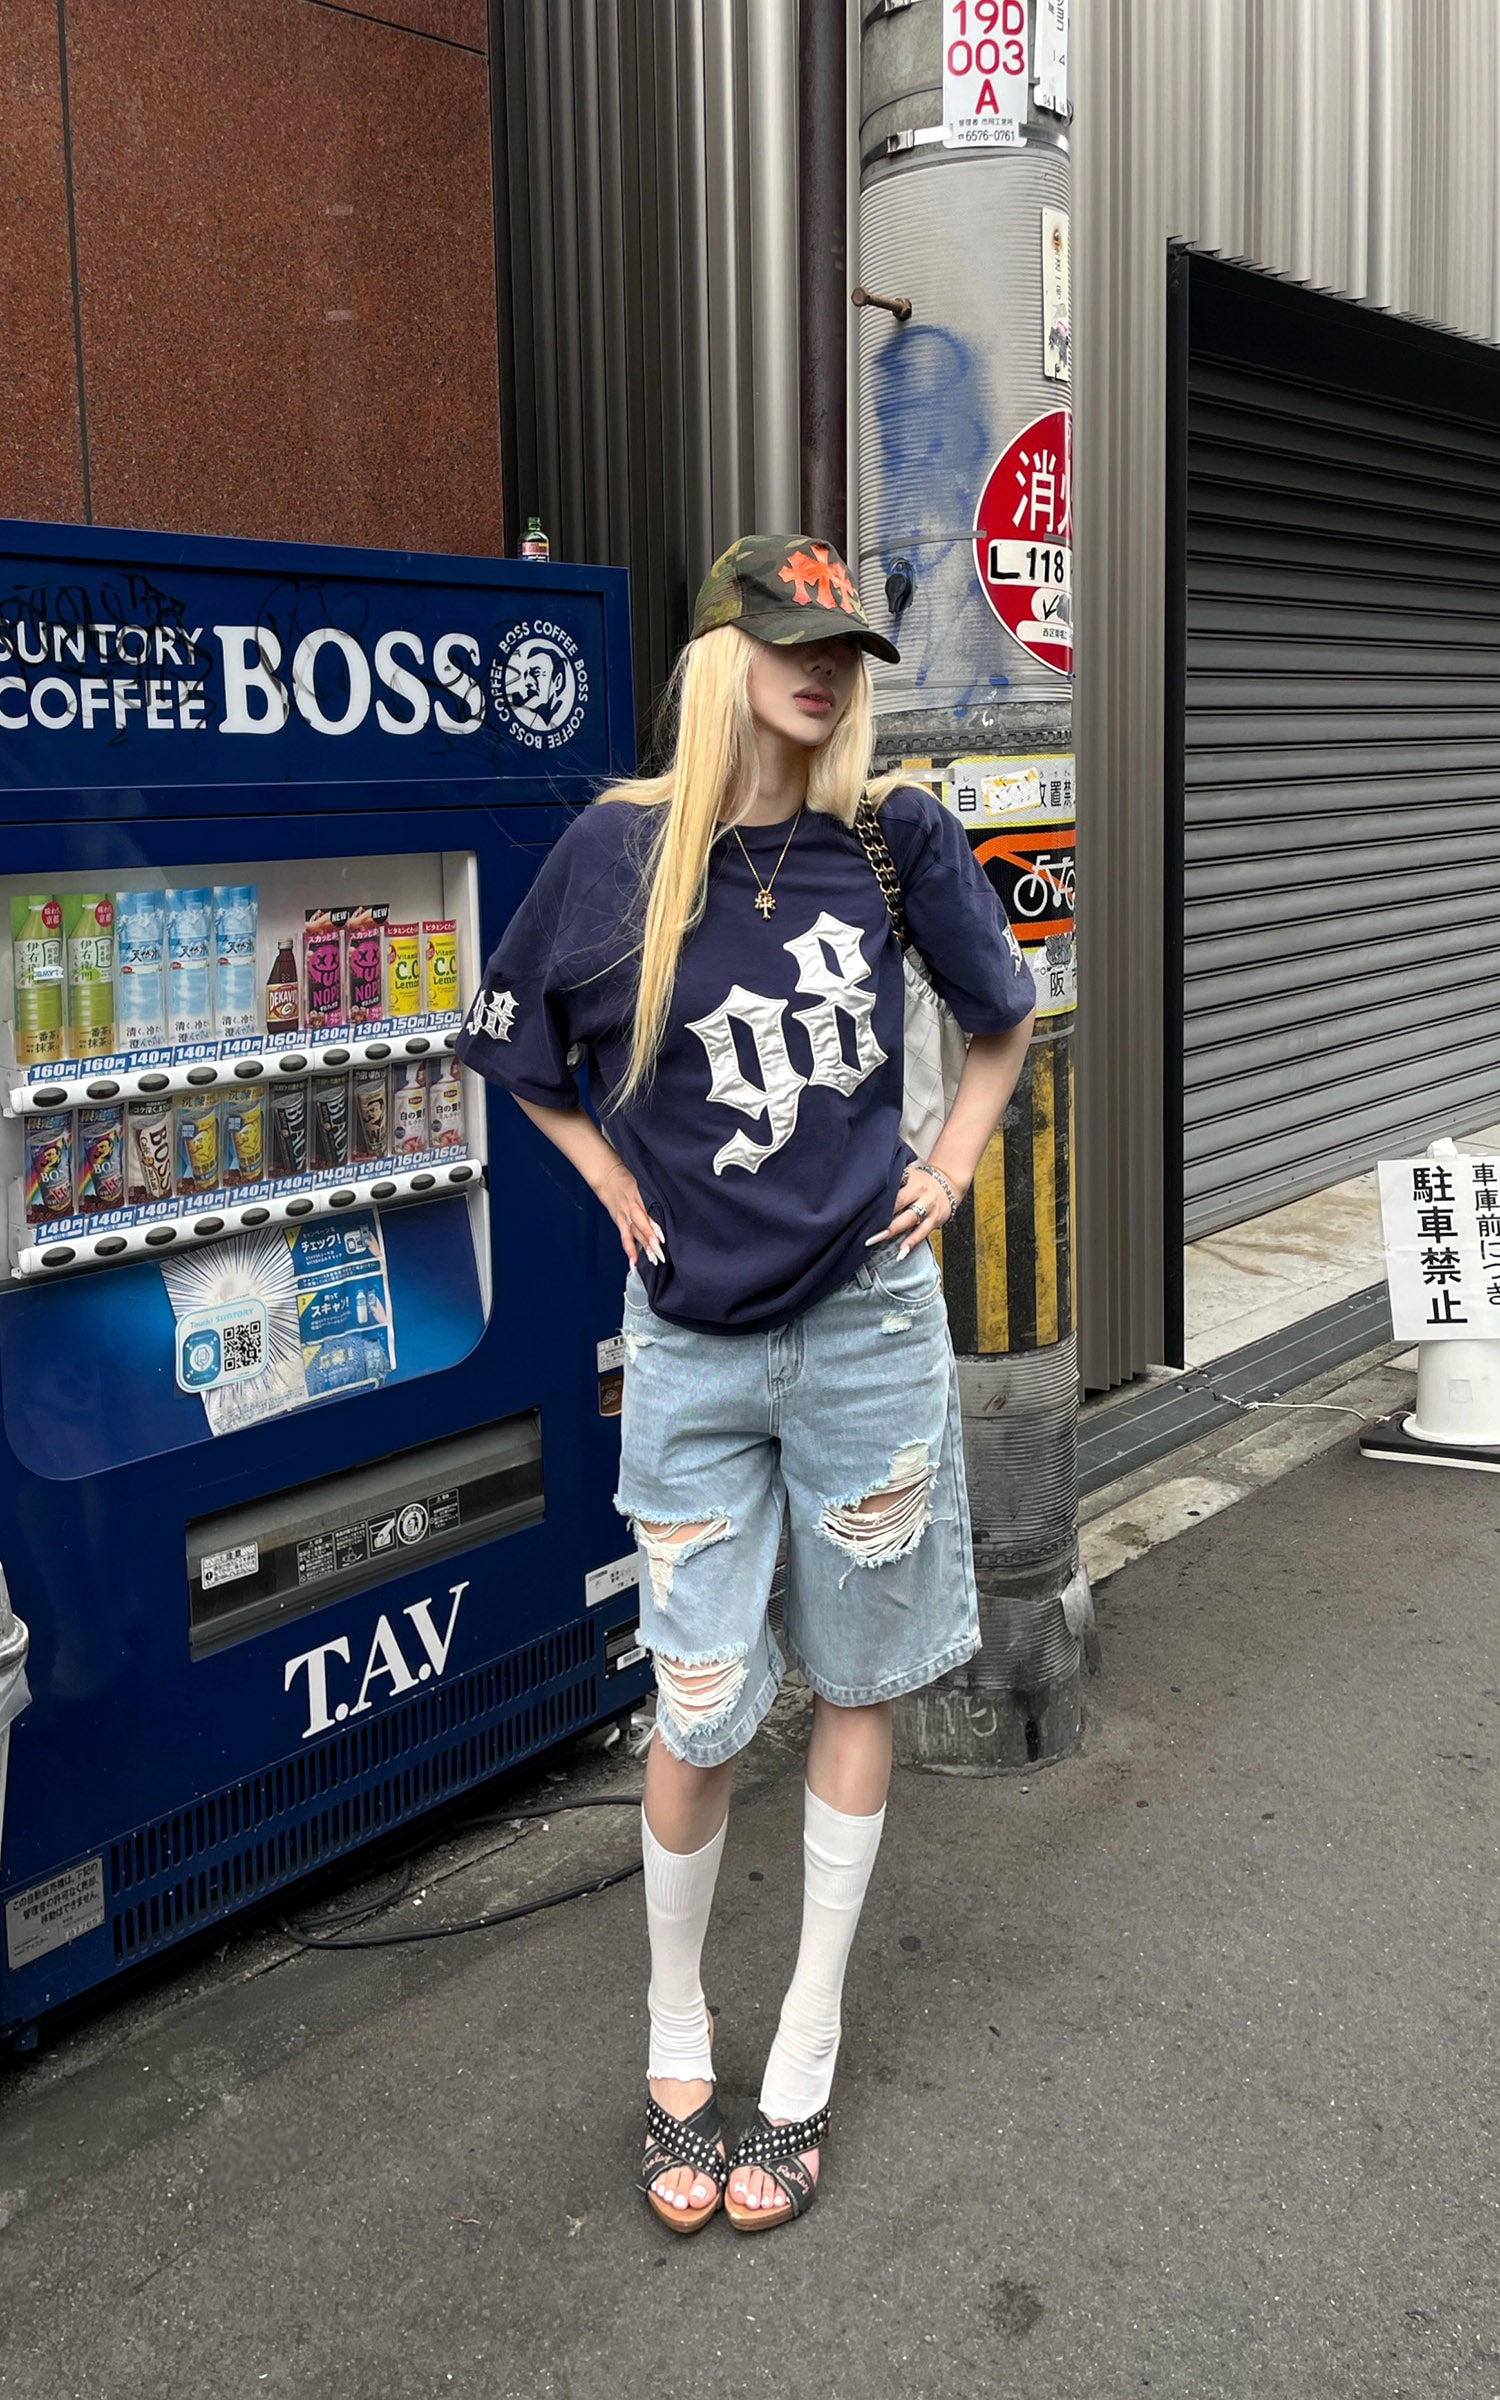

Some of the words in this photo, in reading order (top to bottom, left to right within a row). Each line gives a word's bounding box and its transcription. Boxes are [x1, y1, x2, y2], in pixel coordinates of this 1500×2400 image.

[952, 0, 1024, 35] 19D
[947, 38, 1024, 76] 003
[975, 79, 999, 115] A
[965, 129, 1014, 141] 6576-0761
[1026, 546, 1064, 583] 118
[499, 622, 530, 654] BOSS
[533, 619, 579, 656] COFFEE
[213, 625, 486, 736] BOSS
[574, 659, 589, 702] BOSS
[0, 676, 207, 730] COFFEE
[509, 721, 543, 749] BOSS
[547, 706, 585, 749] COFFEE
[331, 911, 348, 922] NEW
[372, 907, 388, 919] NEW
[392, 1016, 426, 1030] 150円
[430, 1011, 462, 1026] 150円
[313, 1026, 348, 1041] 130円
[356, 1021, 390, 1035] 130円
[224, 1039, 262, 1053] 140円
[268, 1031, 305, 1047] 160円
[129, 1051, 171, 1066] 140円
[176, 1045, 216, 1061] 140円
[31, 1063, 77, 1079] 160円
[83, 1057, 126, 1073] 160円
[149, 1126, 173, 1190] BOSS
[397, 1152, 430, 1167] 160円
[435, 1144, 466, 1159] 160円
[318, 1166, 353, 1182] 140円
[359, 1160, 392, 1174] 130円
[276, 1176, 312, 1191] 140円
[231, 1184, 269, 1200] 140円
[186, 1193, 225, 1208] 140円
[138, 1202, 177, 1218] 140円
[91, 1210, 133, 1228] 140円
[39, 1219, 83, 1237] 140円
[1413, 1165, 1468, 1324] 駐車禁止
[284, 1580, 470, 1739] T.A.V
